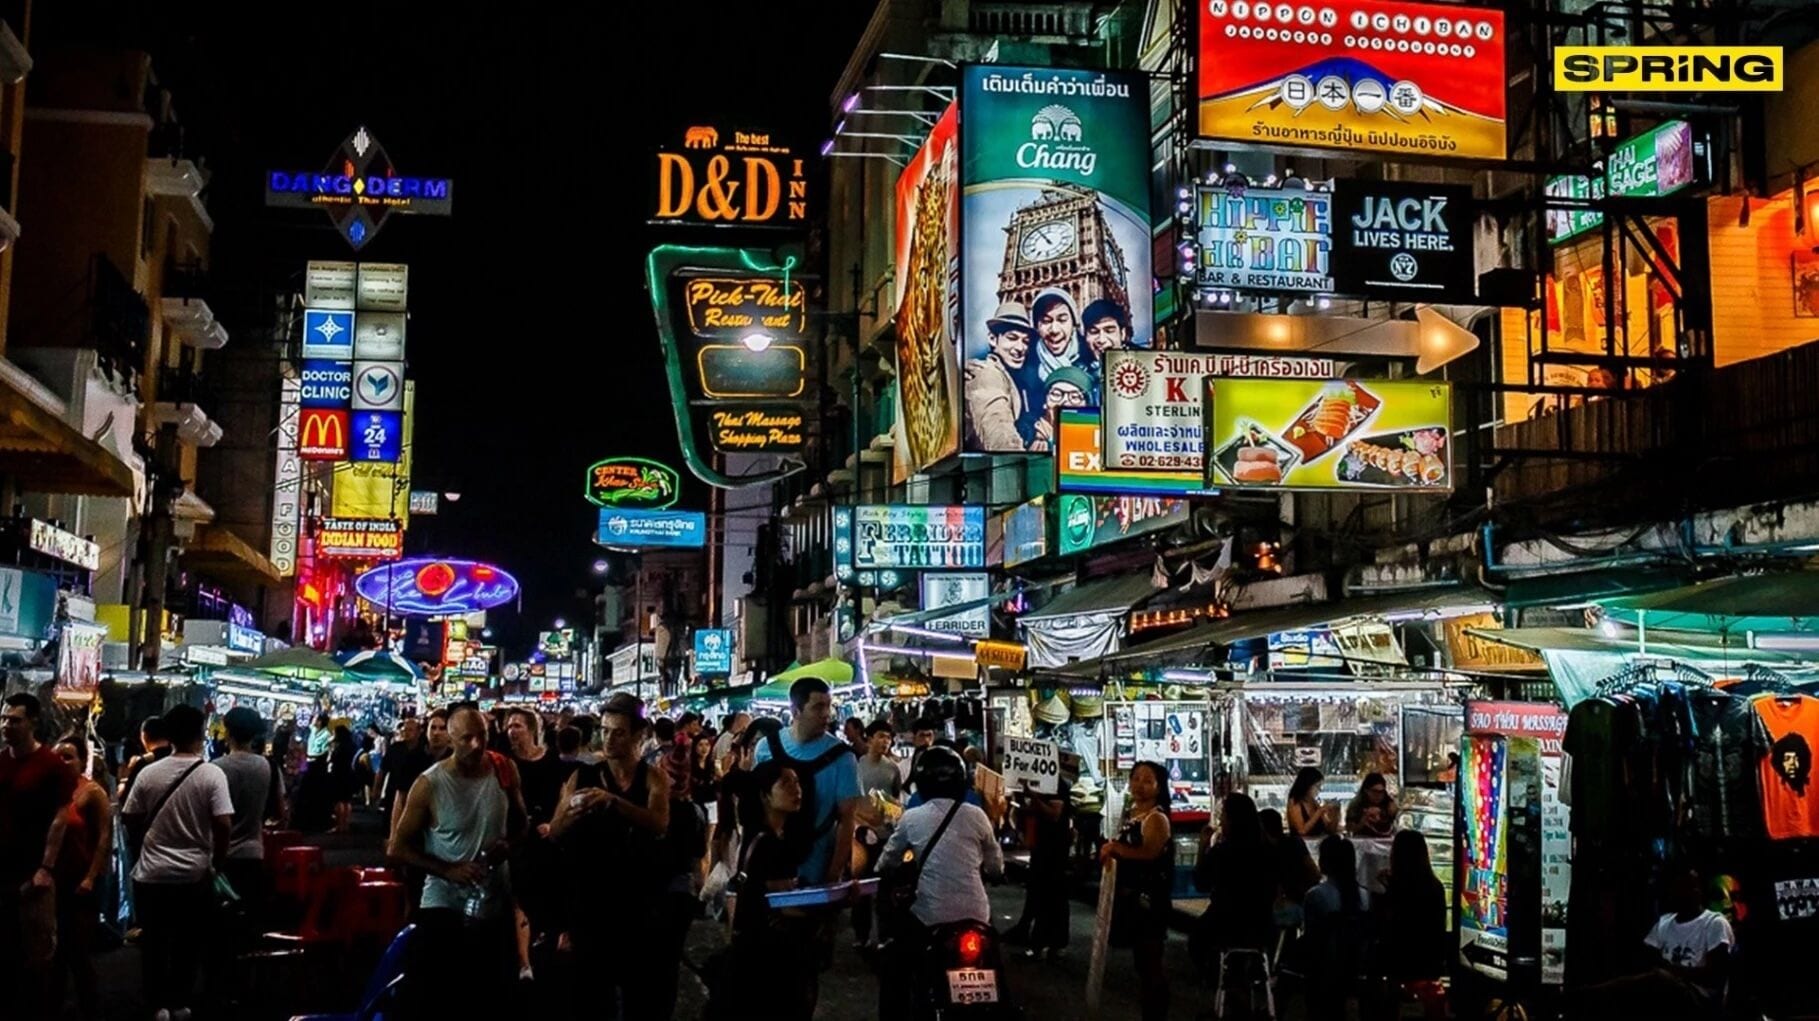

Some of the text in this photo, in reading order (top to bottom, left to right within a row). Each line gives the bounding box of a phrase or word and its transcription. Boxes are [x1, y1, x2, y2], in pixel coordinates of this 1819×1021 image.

[1210, 1, 1493, 39] NIPPON ICHIBAN
[1227, 25, 1331, 45] JAPANESE
[982, 71, 1130, 98] เติมเต็มคำว่าเพื่อน
[1288, 79, 1418, 109] 日本一番
[1252, 120, 1364, 145] ร้านอาหารญี่ปุ่น
[1016, 142, 1097, 175] Chang
[270, 171, 448, 199] DANG DERM
[655, 153, 781, 221] D&D
[788, 159, 807, 220] INN
[1351, 195, 1449, 233] JACK
[1353, 230, 1454, 251] LIVES HERE.
[1199, 270, 1330, 289] BAR & RESTAURANT
[692, 281, 802, 307] Pick-Thai
[302, 370, 351, 382] DOCTOR
[301, 386, 351, 399] CLINIC
[1145, 405, 1203, 417] STERLIN
[364, 428, 387, 444] 24
[276, 502, 293, 572] FOOD
[366, 532, 398, 548] FOOD
[1010, 739, 1051, 757] BUCKETS
[1004, 753, 1057, 776] 3 For 400
